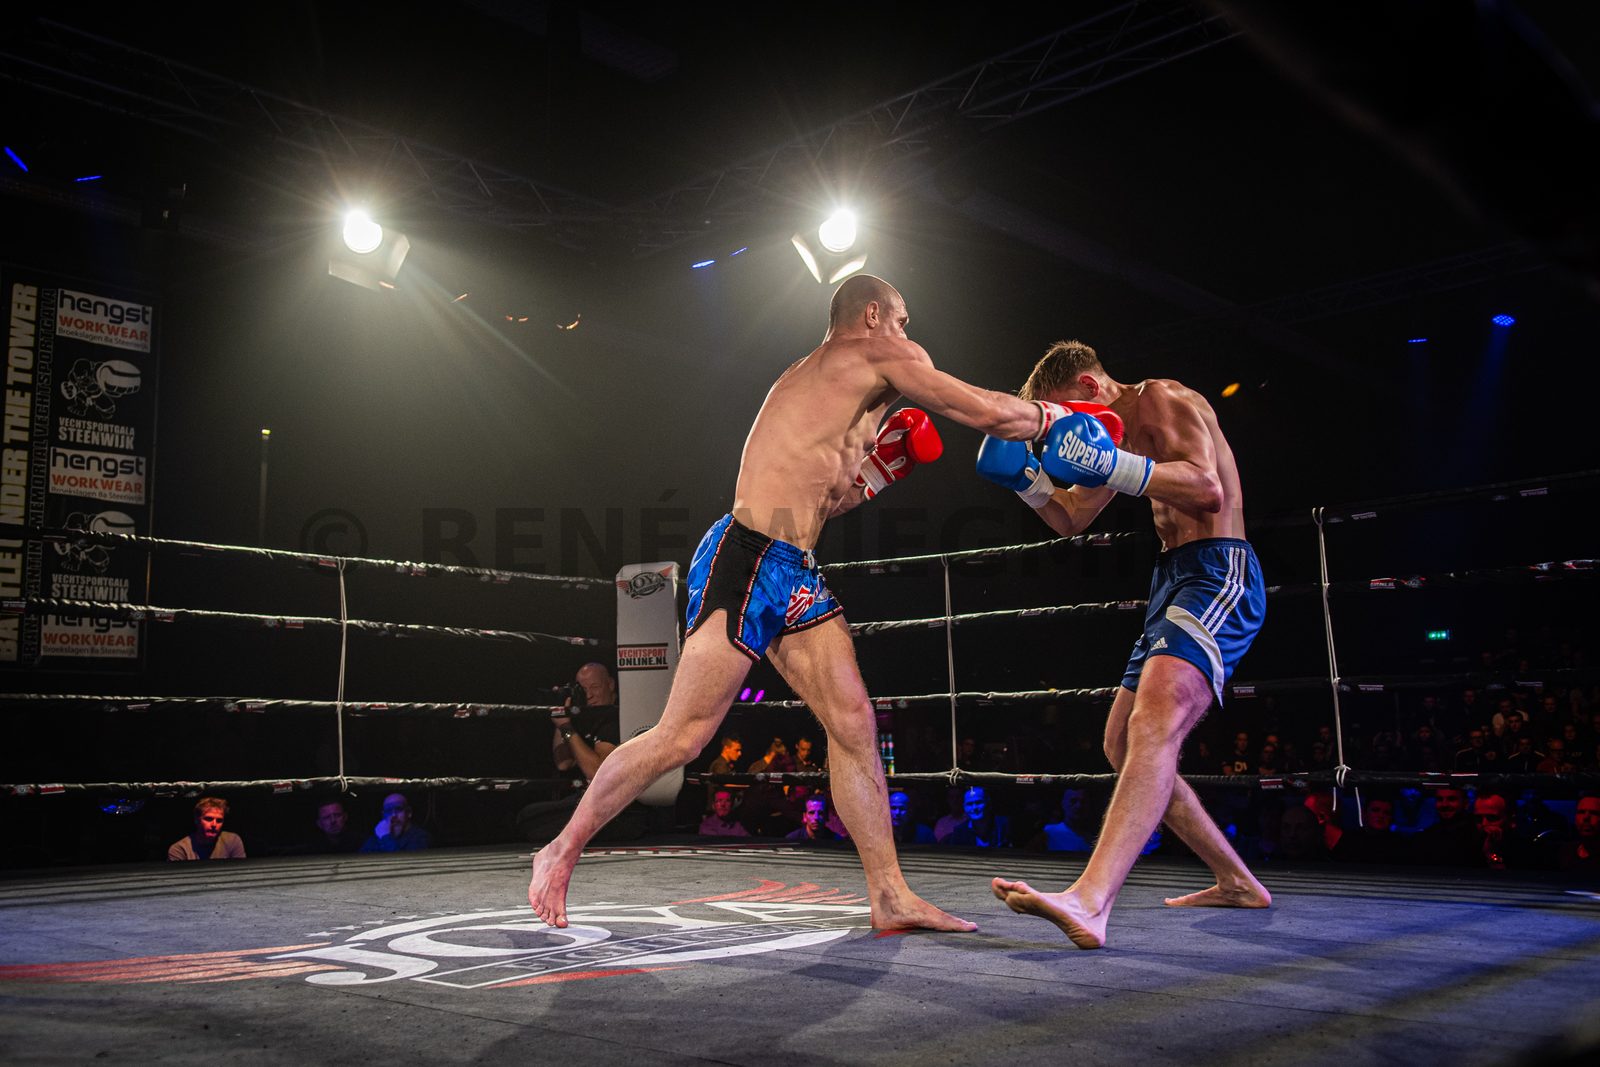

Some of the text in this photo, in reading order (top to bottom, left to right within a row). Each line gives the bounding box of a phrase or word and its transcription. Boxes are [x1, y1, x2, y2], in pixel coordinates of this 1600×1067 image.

[60, 291, 150, 325] hengst
[6, 282, 38, 386] TOWER
[59, 315, 149, 342] WORKWEAR
[35, 288, 55, 437] VECHTSPORTGALA
[3, 389, 32, 445] THE
[59, 417, 135, 436] VECHTSPORTGALA
[58, 427, 135, 450] STEENWIJK
[1058, 430, 1098, 468] SUPER
[52, 448, 144, 478] hengst
[51, 474, 143, 494] WORKWEAR
[51, 584, 129, 601] STEENWIJK
[52, 573, 129, 588] VECHTSPORTGALA
[0, 552, 22, 662] BATLE
[43, 633, 136, 647] WORKWEAR
[618, 648, 668, 658] VECHTSPORT
[618, 657, 668, 667] ONLINE.NL
